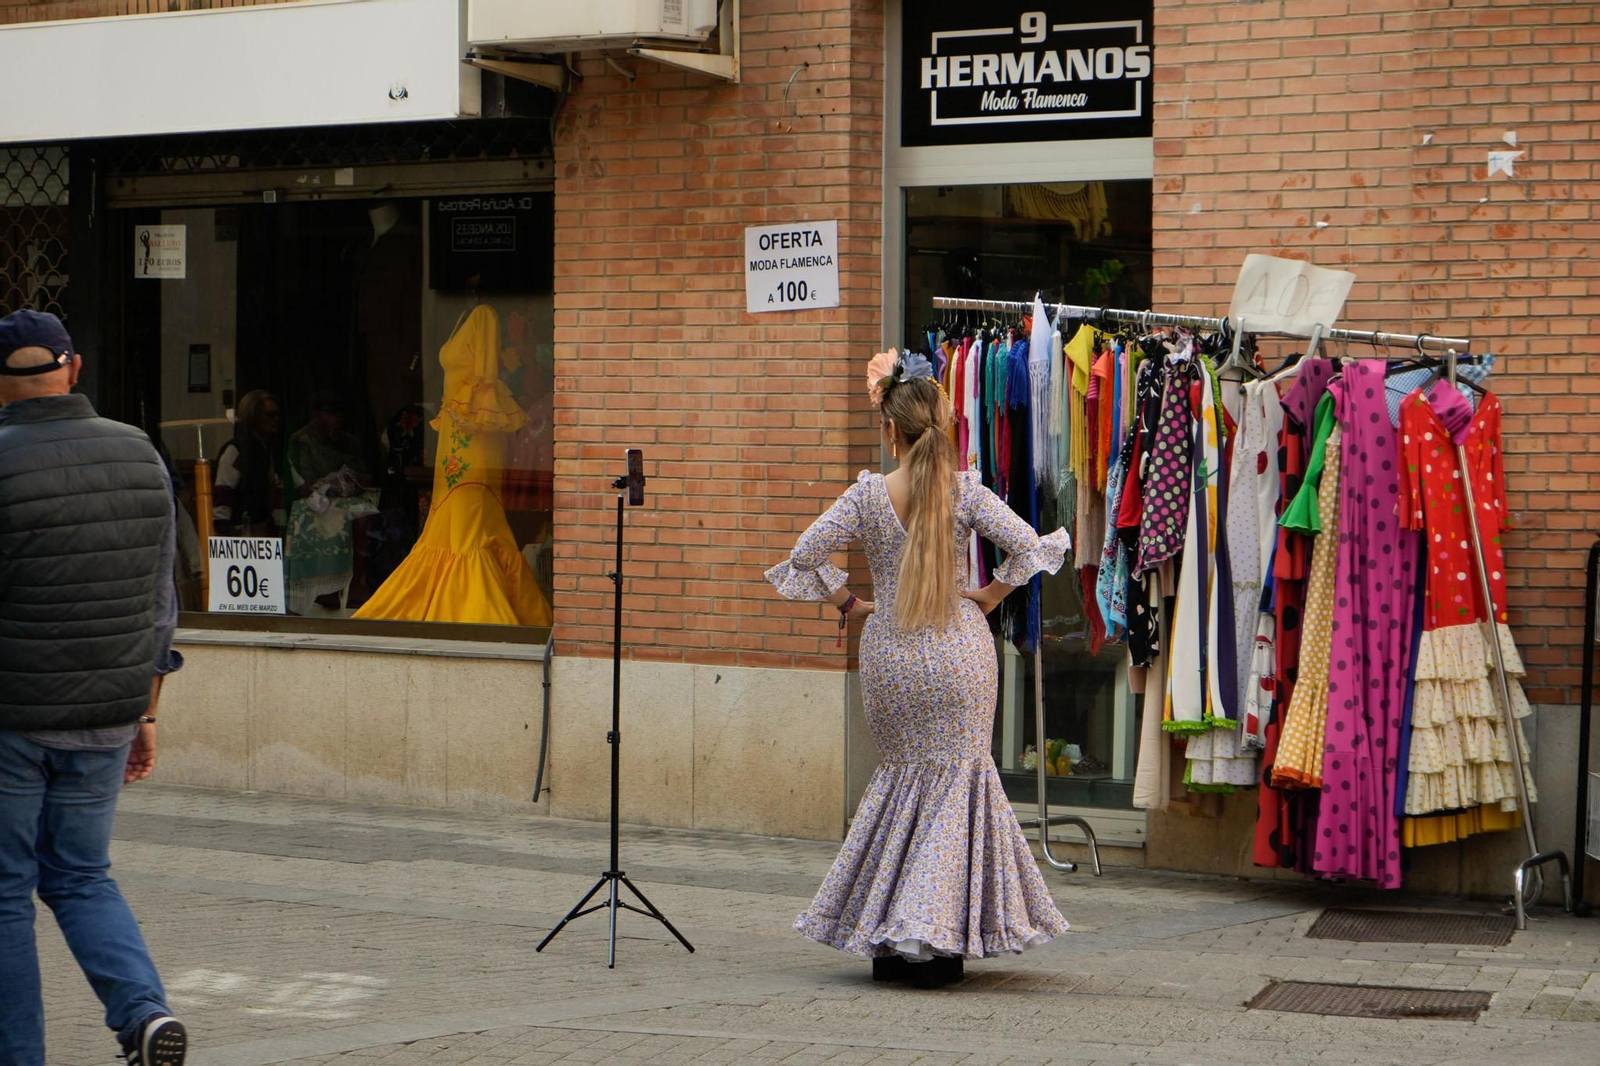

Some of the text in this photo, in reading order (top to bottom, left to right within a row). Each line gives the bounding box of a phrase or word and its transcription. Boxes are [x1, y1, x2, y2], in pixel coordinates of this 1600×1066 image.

[1020, 11, 1047, 44] 9
[920, 45, 1151, 88] HERMANOS
[981, 88, 1088, 111] Moda Flamenca
[759, 230, 823, 251] OFERTA
[750, 255, 833, 271] MODA FLAMENCA
[767, 293, 774, 303] A
[209, 539, 282, 560] MANTONES A
[227, 565, 269, 598] 60€
[228, 603, 235, 611] EL
[259, 604, 278, 612] MARZO
